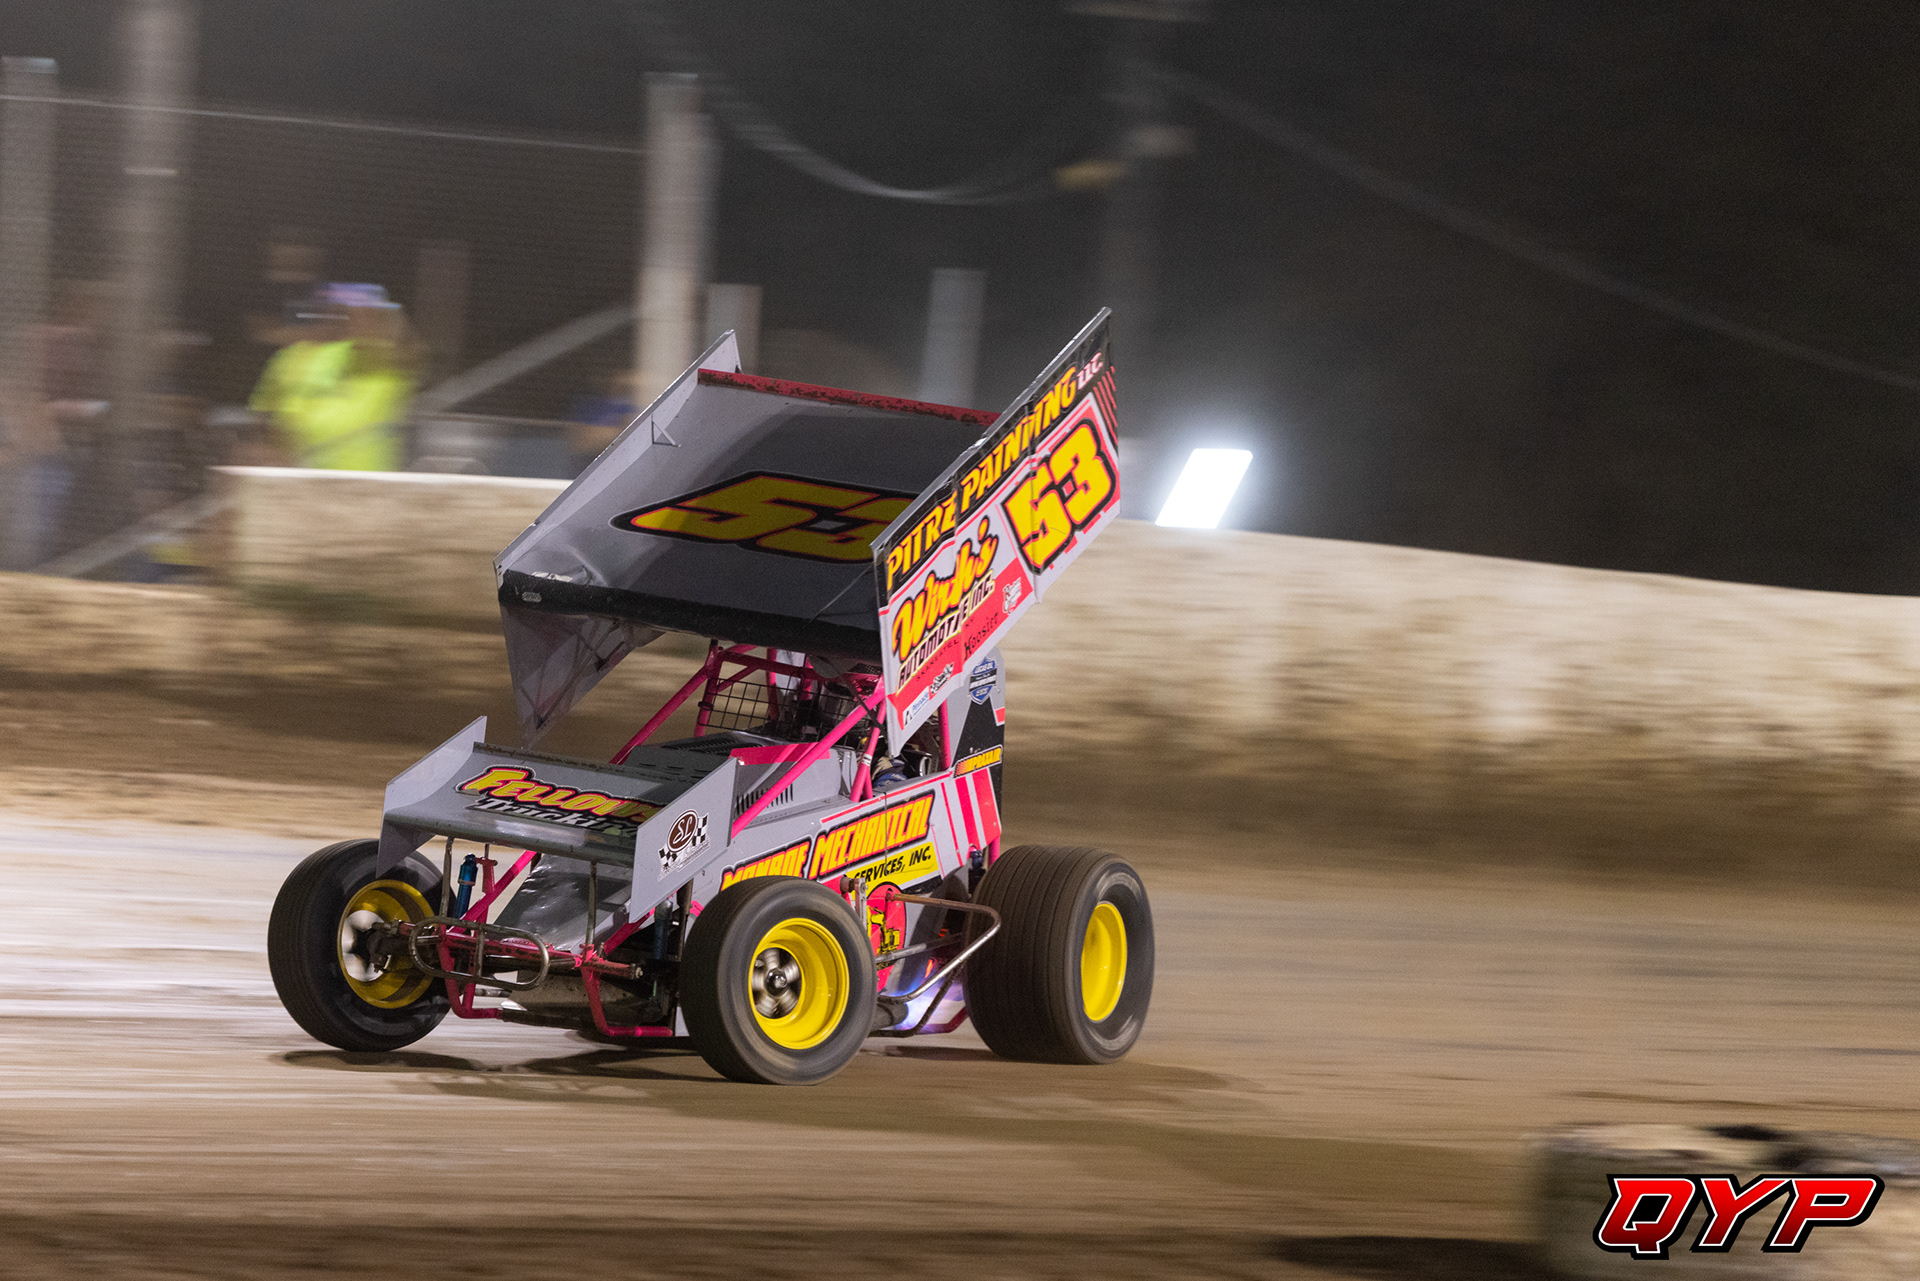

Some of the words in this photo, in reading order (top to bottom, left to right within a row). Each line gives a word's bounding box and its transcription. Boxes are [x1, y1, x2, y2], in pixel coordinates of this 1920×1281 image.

[627, 474, 920, 562] 53
[886, 490, 957, 591] PITRE
[960, 367, 1077, 514] PAINTING
[1003, 421, 1114, 572] 53
[897, 597, 970, 694] AUTOMOTIE
[807, 793, 935, 881] MECHANICAL
[909, 846, 932, 867] INC.
